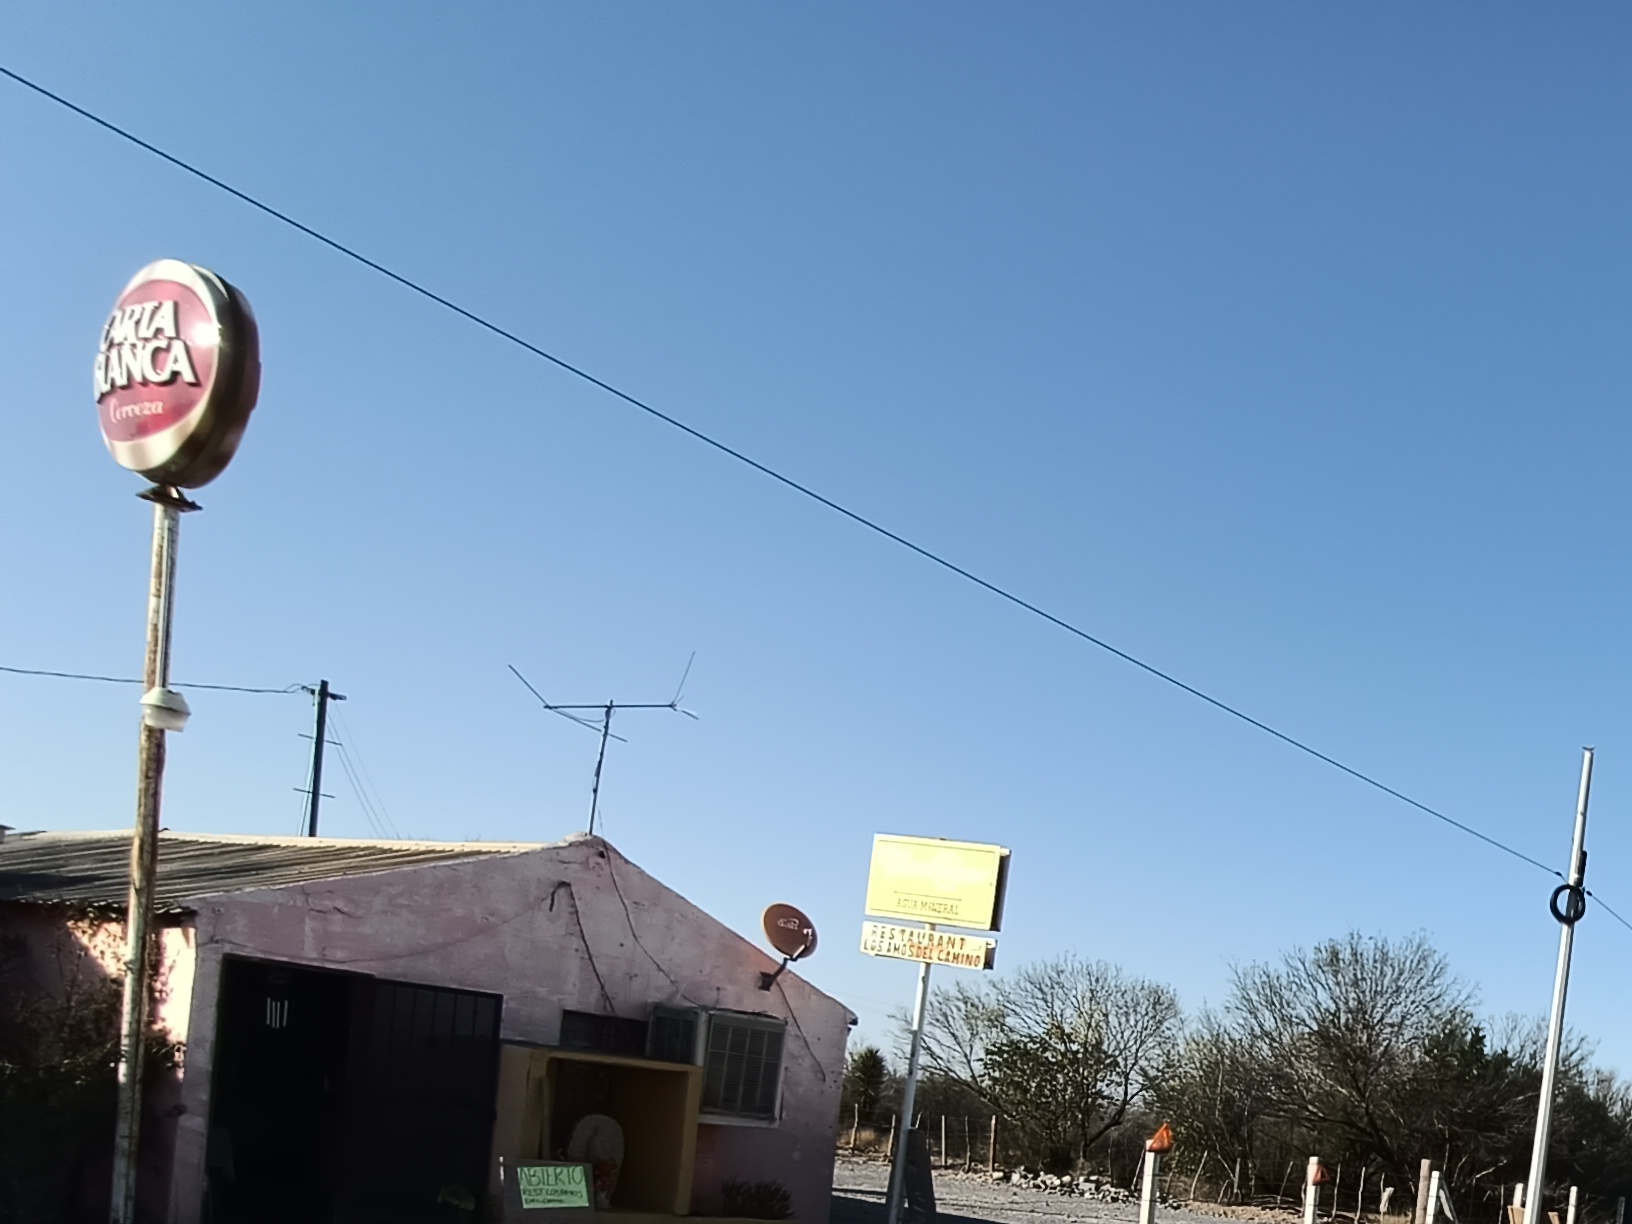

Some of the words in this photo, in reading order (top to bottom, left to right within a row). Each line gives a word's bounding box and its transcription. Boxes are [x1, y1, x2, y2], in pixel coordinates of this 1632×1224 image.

[870, 924, 967, 951] RESTAURANT
[863, 938, 883, 953] LOS
[915, 945, 934, 961] DEL
[937, 949, 982, 968] CAMINO
[519, 1166, 584, 1187] ABIERTO
